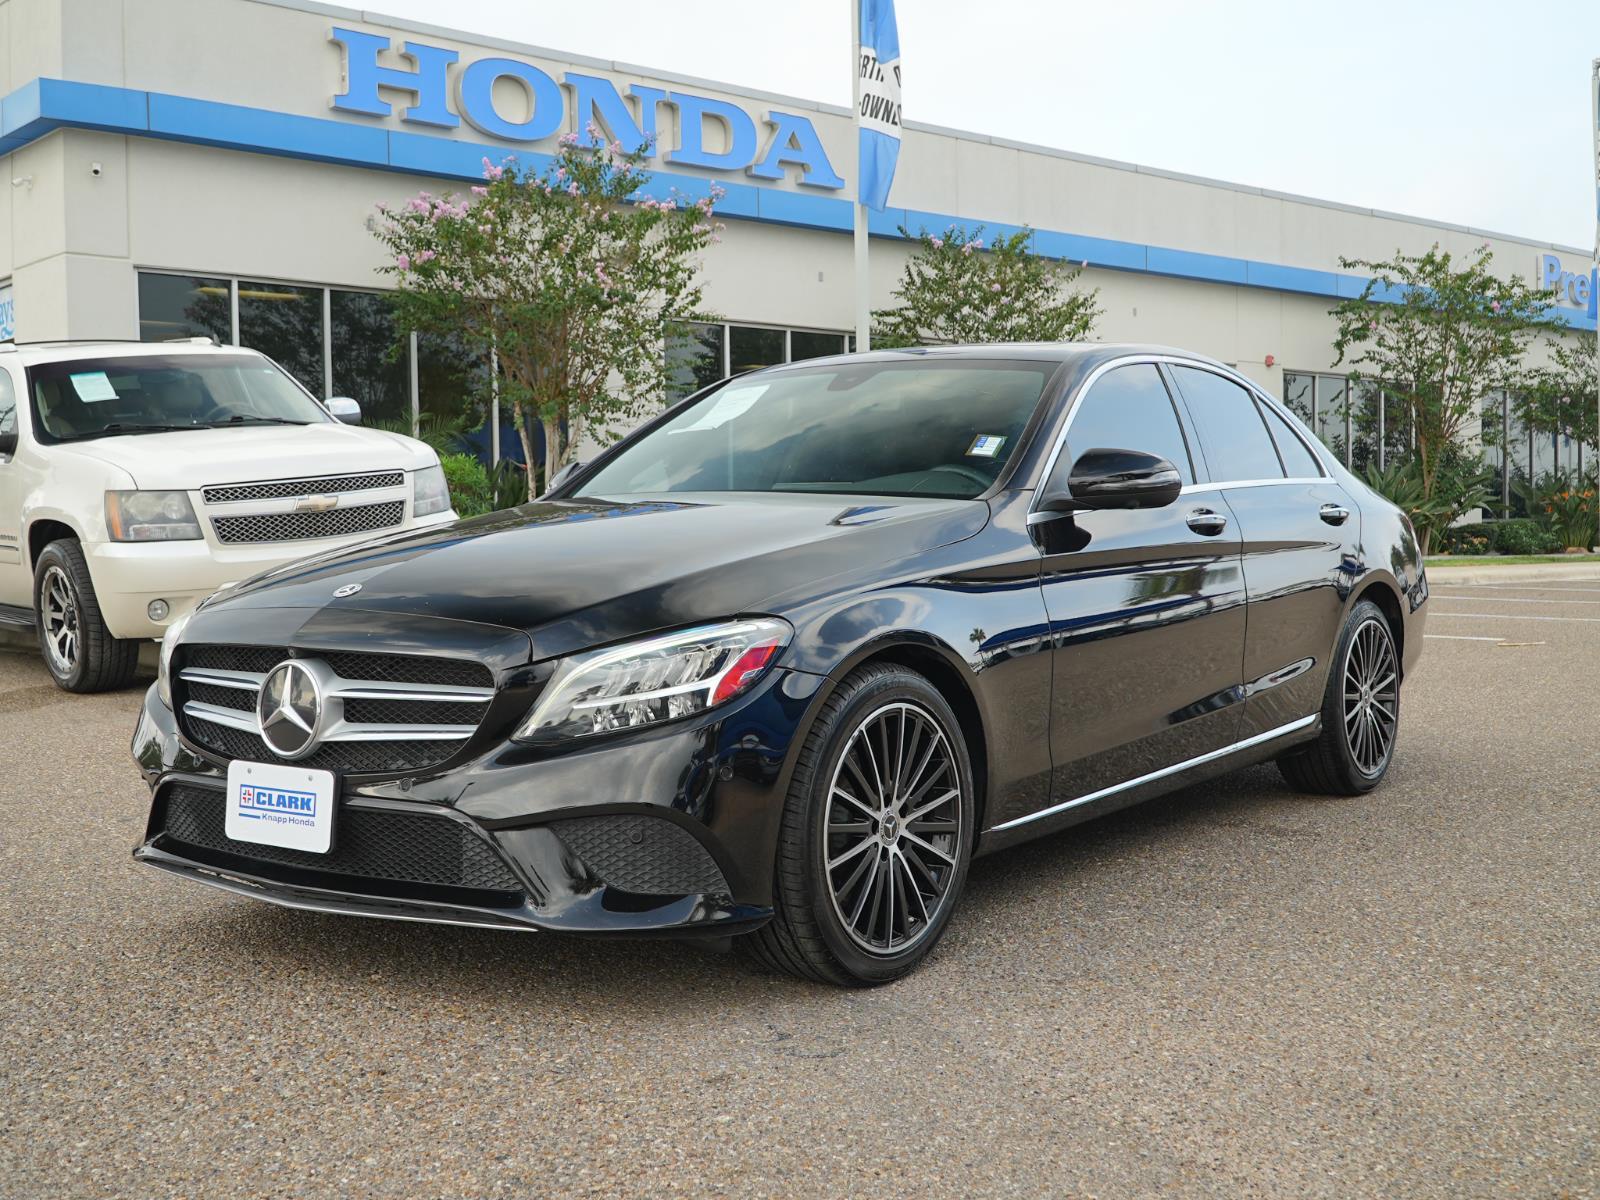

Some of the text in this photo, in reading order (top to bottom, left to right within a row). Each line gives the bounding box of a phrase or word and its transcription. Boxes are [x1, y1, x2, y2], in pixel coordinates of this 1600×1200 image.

[329, 26, 845, 190] HONDA
[256, 791, 312, 812] CLARK
[262, 813, 315, 827] Knapp Honda
